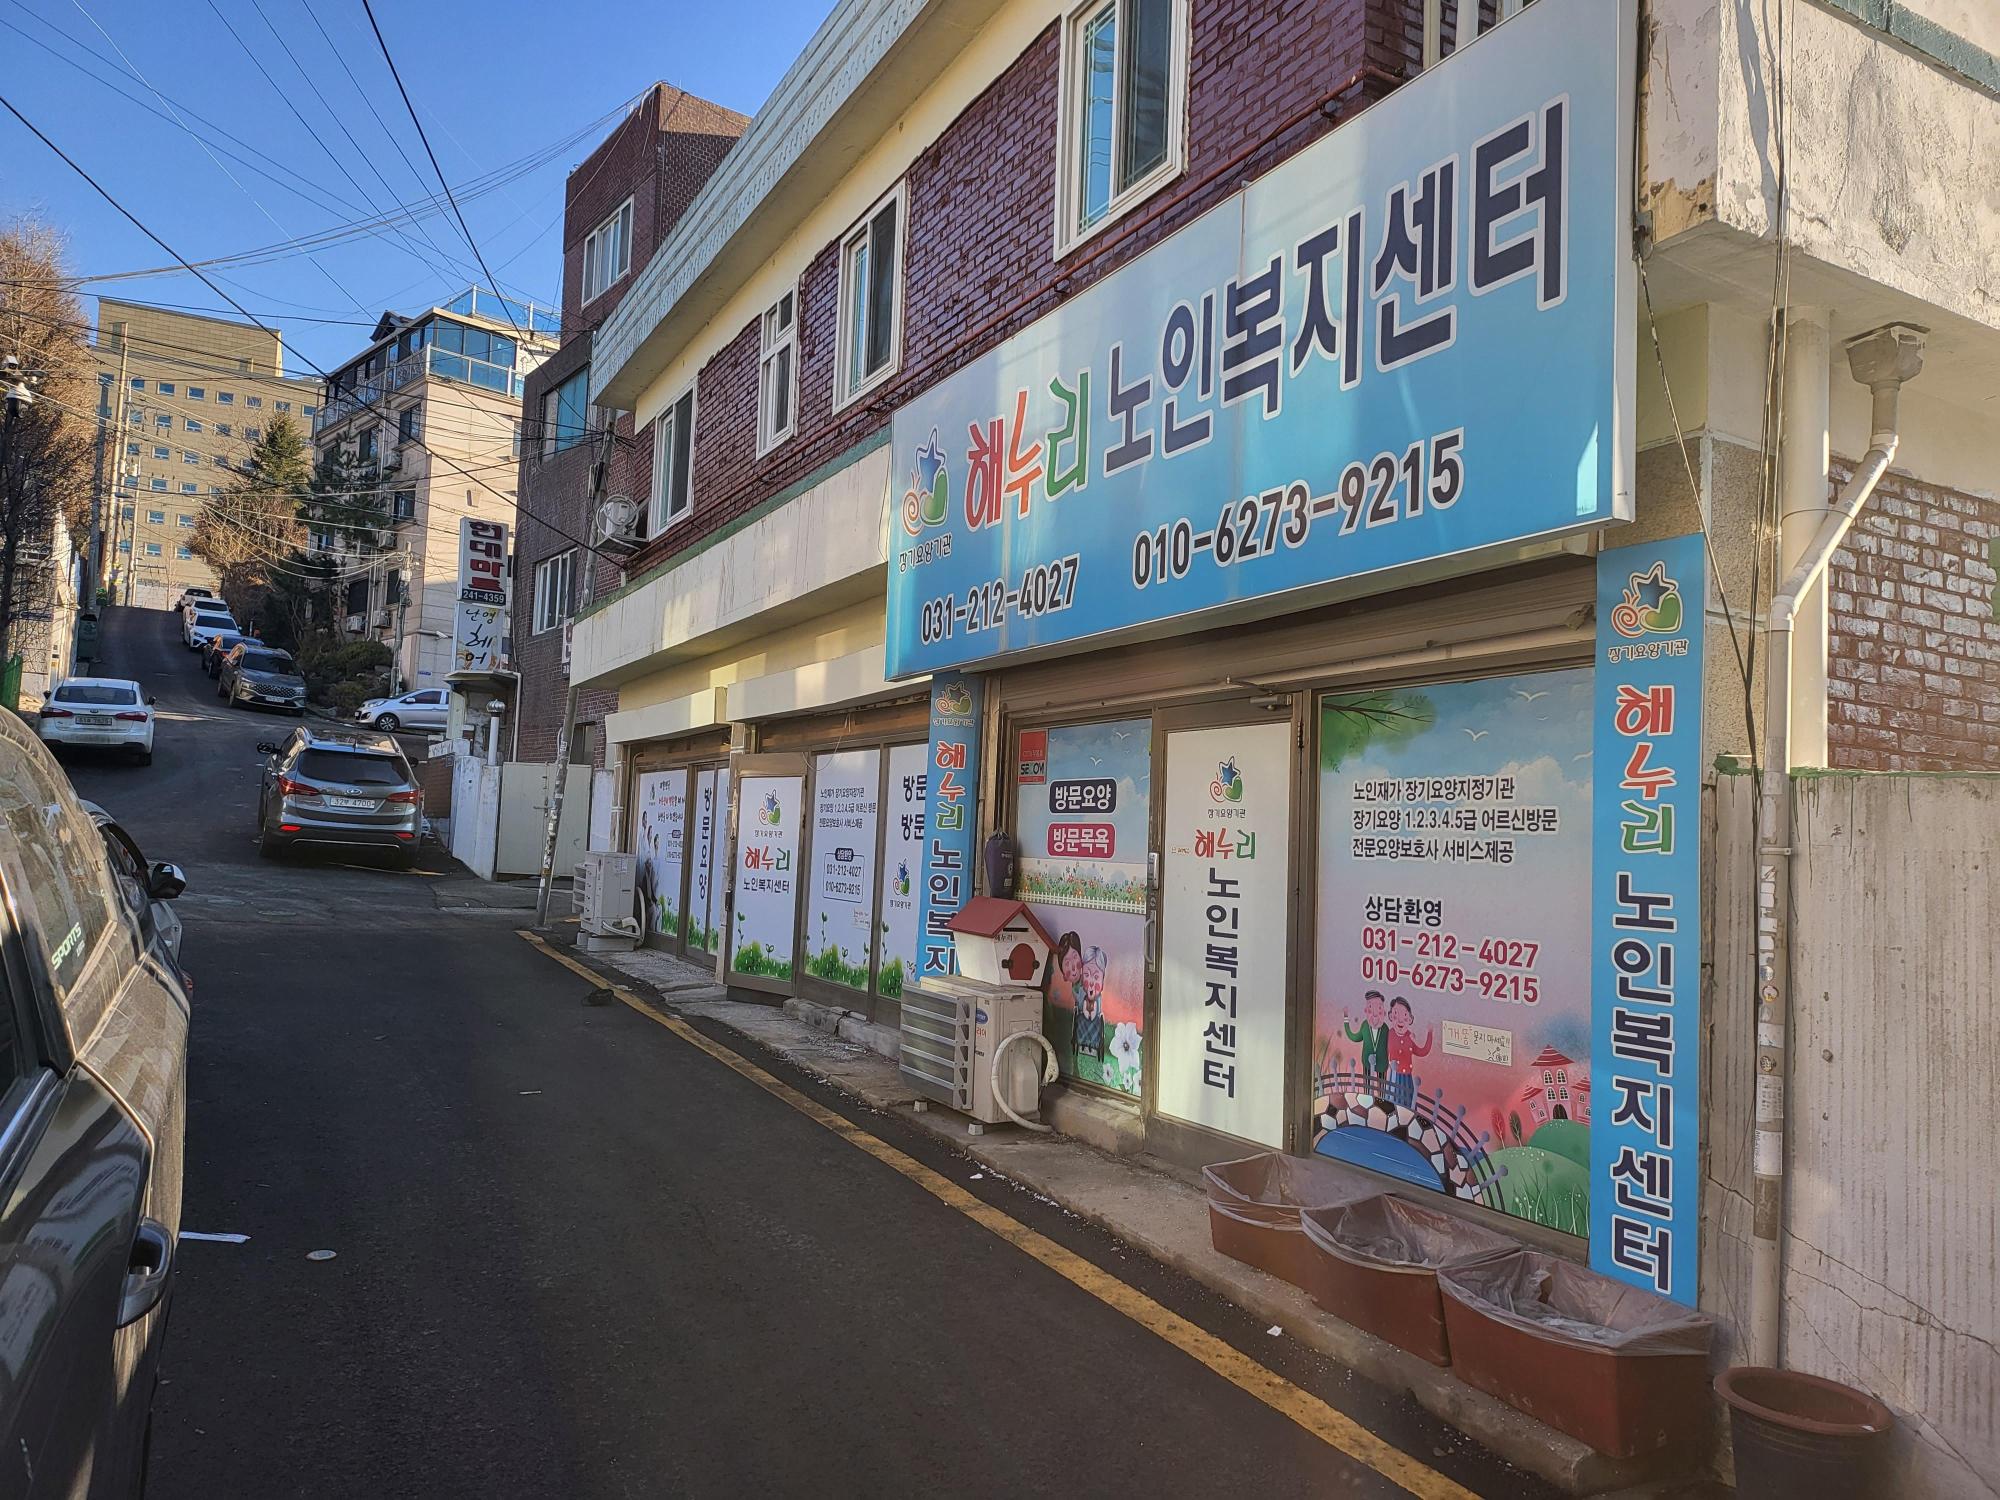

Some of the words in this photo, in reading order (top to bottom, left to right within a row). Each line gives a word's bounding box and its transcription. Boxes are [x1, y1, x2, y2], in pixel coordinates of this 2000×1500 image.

[964, 369, 1092, 531] 해누리
[1102, 99, 1565, 477] 노인복지센터
[1132, 432, 1462, 589] 010-6273-9215
[898, 533, 952, 572] 장기요양기관
[463, 590, 504, 603] 241-4359
[921, 556, 1079, 645] 031-212-4027
[1609, 640, 1687, 661] 장기요양기관
[935, 741, 966, 830] 해누리
[1614, 686, 1675, 854] 해누리
[1055, 784, 1112, 810] 방문요양
[1353, 780, 1401, 801] 노인재가
[1405, 777, 1515, 801] 장기요양지정기관
[1207, 808, 1246, 818] 장기요양기관
[1353, 810, 1401, 830] 장기요양
[1405, 809, 1477, 831] 1.2.3.4.5급
[699, 787, 712, 899] 방문요양
[1053, 828, 1109, 854] 방문목욕
[1194, 827, 1256, 860] 해누리
[1352, 838, 1439, 861] 전문요양보호사
[1442, 839, 1514, 864] 서비스제공
[744, 846, 791, 871] 해누리
[826, 863, 862, 878] 031-212-4027
[743, 877, 790, 894] 노인복지센터
[825, 881, 861, 895] 010-6273-9215
[1365, 896, 1442, 927] 상담환영
[51, 921, 81, 970] SPORTS
[1203, 867, 1241, 1099] 노인복지센터
[1362, 957, 1538, 1003] 010-6273-9215
[1610, 873, 1676, 1293] 노인복지센터
